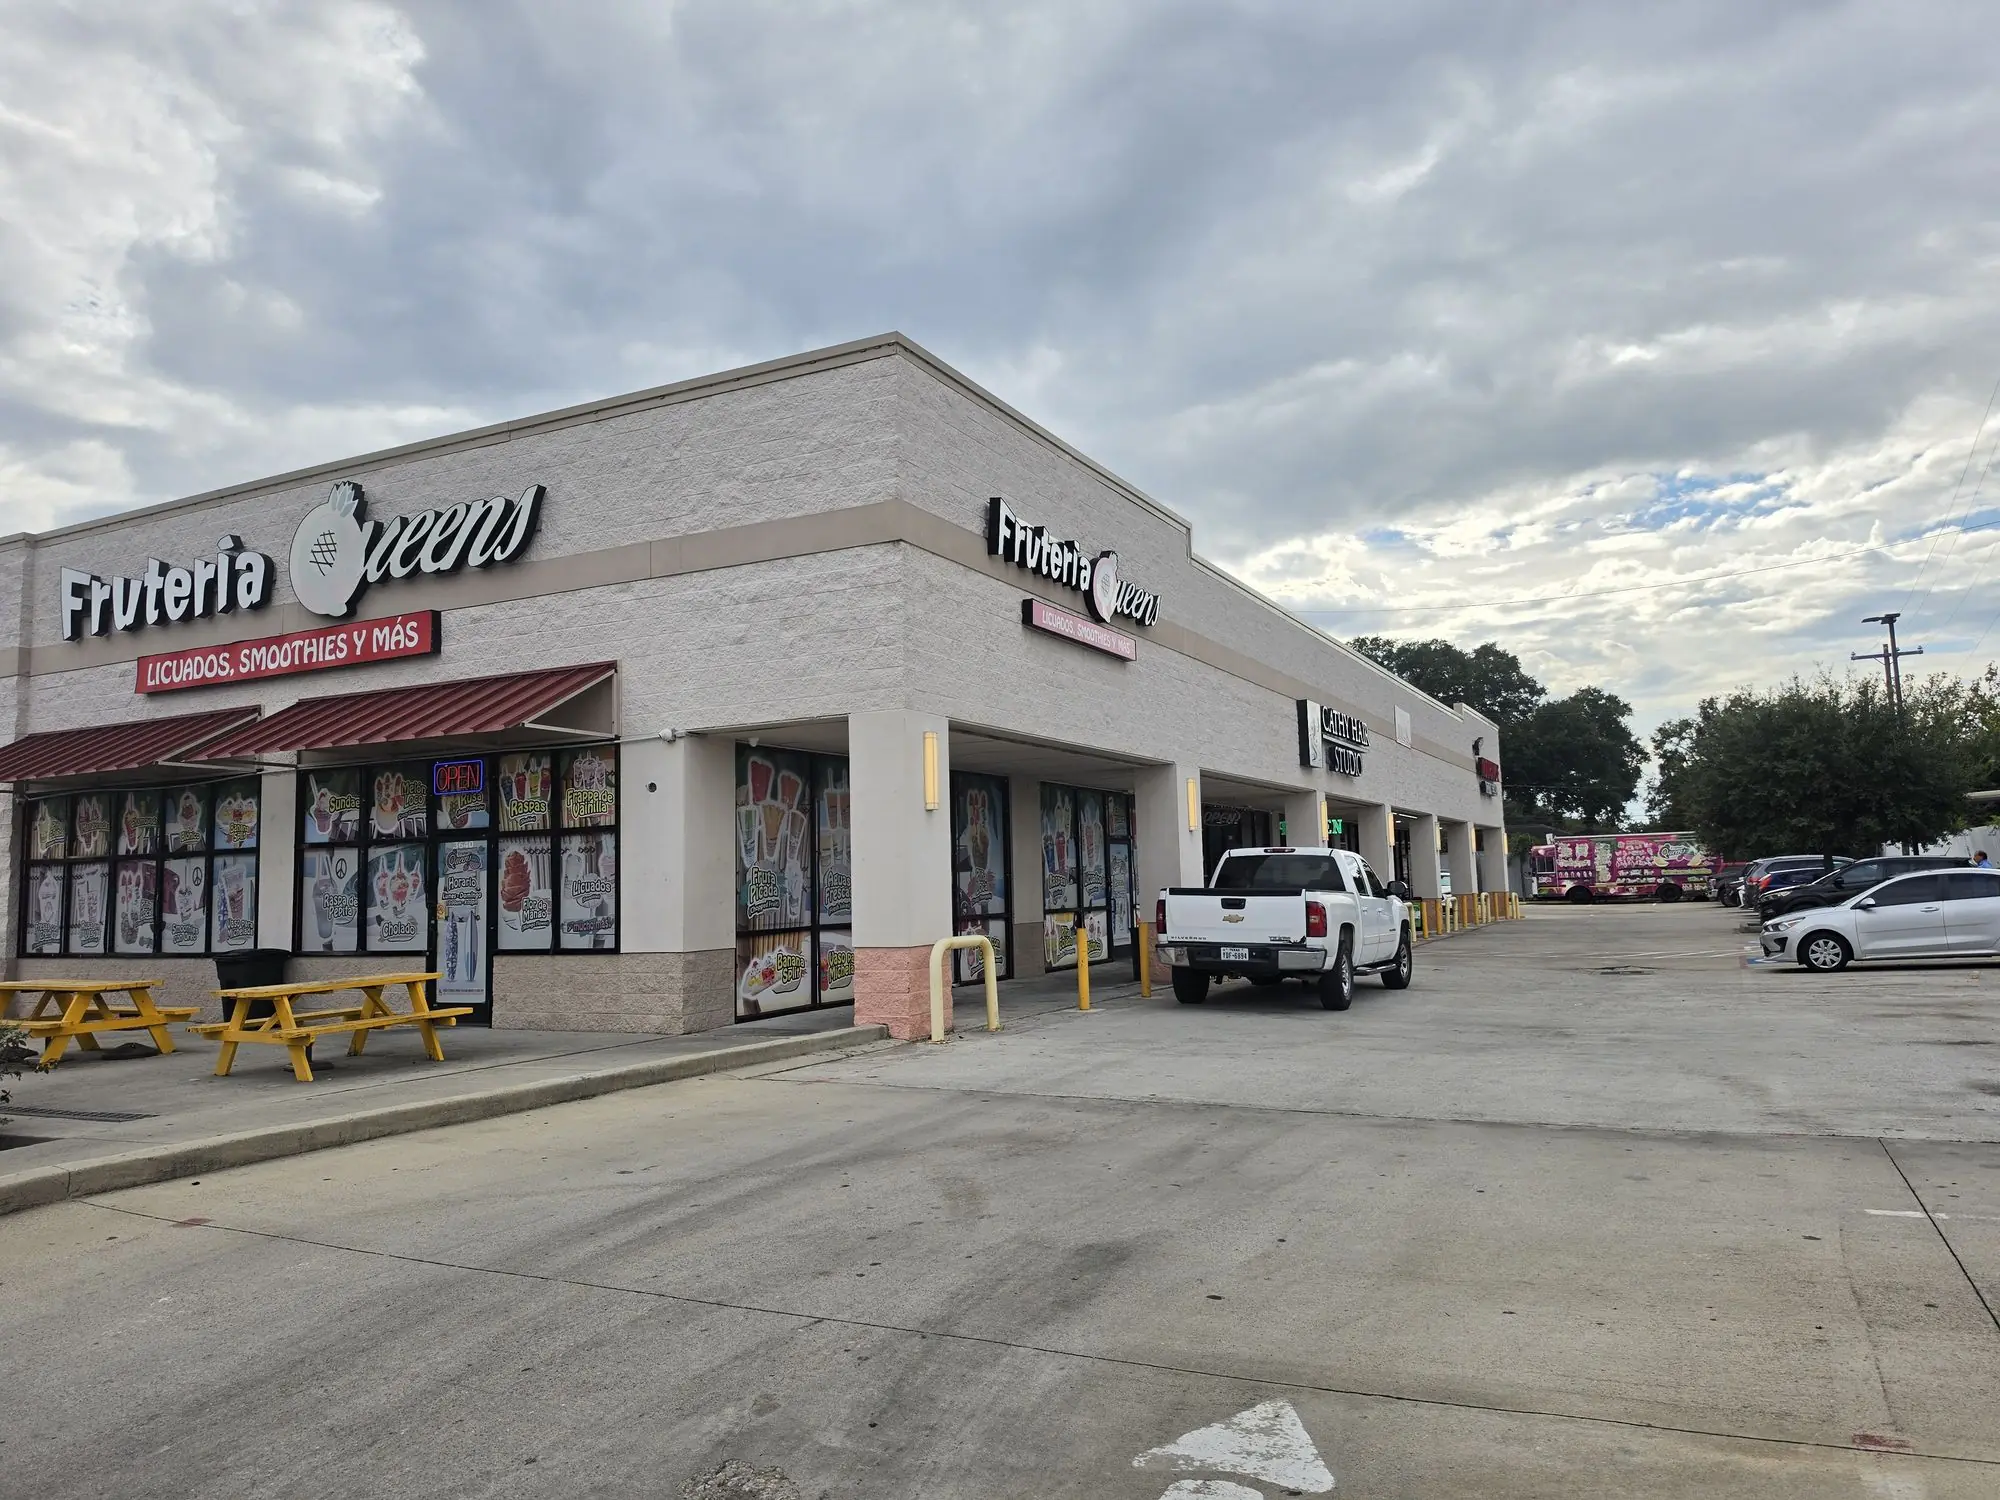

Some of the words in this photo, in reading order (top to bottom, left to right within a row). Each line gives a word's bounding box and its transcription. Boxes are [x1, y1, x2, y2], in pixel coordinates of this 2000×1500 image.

[998, 497, 1091, 591] Fruteria
[60, 534, 272, 642] Fruteria
[1042, 609, 1076, 636] LICUADOS,
[1077, 623, 1110, 648] SMOOTHIES
[147, 651, 234, 686] LICUADOS,
[240, 633, 347, 674] SMOOTHIES
[353, 629, 367, 656] Y
[372, 616, 419, 652] MÁS
[1322, 705, 1350, 739] CATHY
[1351, 716, 1370, 746] HAIR
[1334, 746, 1362, 776] STUDIO
[436, 763, 480, 791] OPEN
[401, 779, 427, 796] Melón
[329, 794, 359, 813] Sundae
[405, 794, 426, 808] Loco
[460, 792, 484, 806] Rusa
[567, 789, 599, 806] Frappe
[601, 790, 614, 804] de
[510, 799, 547, 818] Raspas
[572, 801, 608, 819] Vainilla
[448, 877, 477, 890] Horario
[752, 867, 777, 886] Fruta
[827, 871, 851, 888] Aguas
[572, 880, 612, 896] Licuados
[750, 883, 779, 904] Picada
[825, 888, 851, 905] Fresca
[323, 892, 348, 909] Raspa
[348, 895, 358, 907] de
[523, 897, 537, 910] Flor
[538, 899, 548, 911] de
[328, 906, 354, 921] Pepita
[523, 909, 547, 923] Mango
[381, 921, 417, 938] Cholado
[777, 953, 805, 971] Banana
[829, 950, 846, 966] Vaso
[782, 967, 802, 984] Split
[829, 963, 855, 983] Michela
